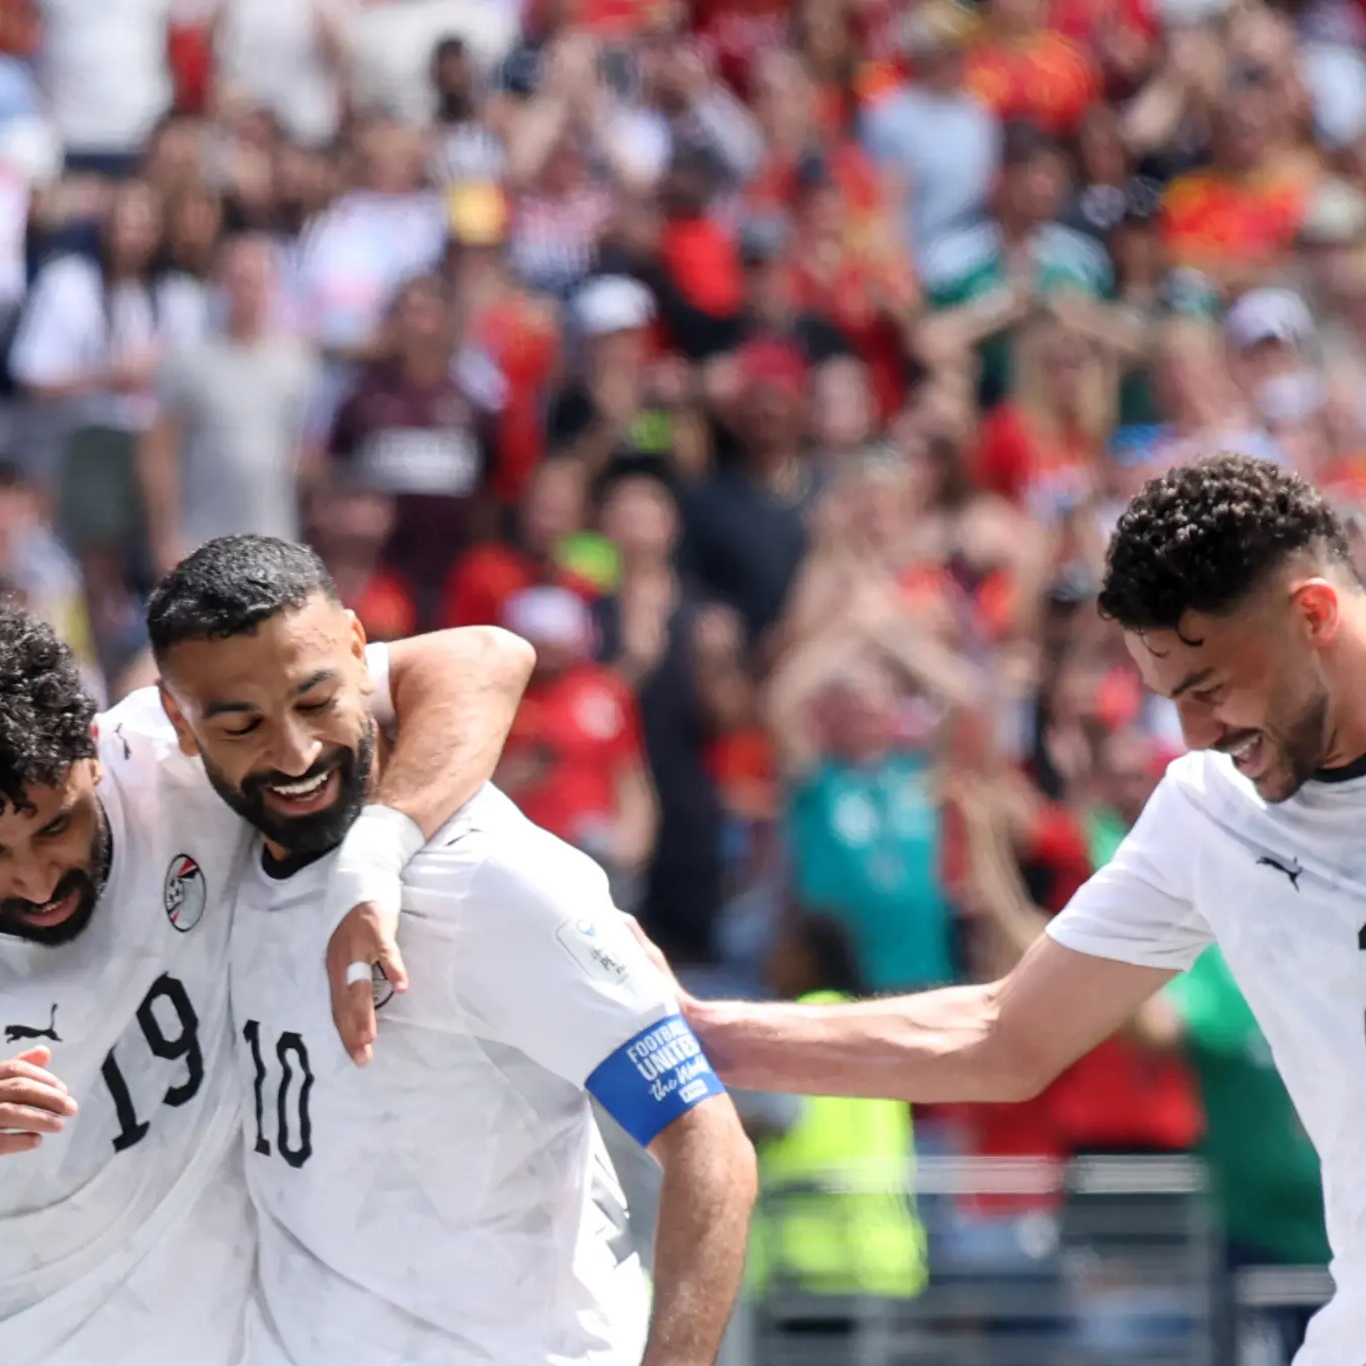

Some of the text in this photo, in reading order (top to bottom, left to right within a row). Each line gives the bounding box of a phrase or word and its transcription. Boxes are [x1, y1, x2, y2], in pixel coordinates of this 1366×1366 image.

[101, 971, 205, 1154] 19
[242, 1019, 315, 1169] 10
[648, 1077, 678, 1102] the
